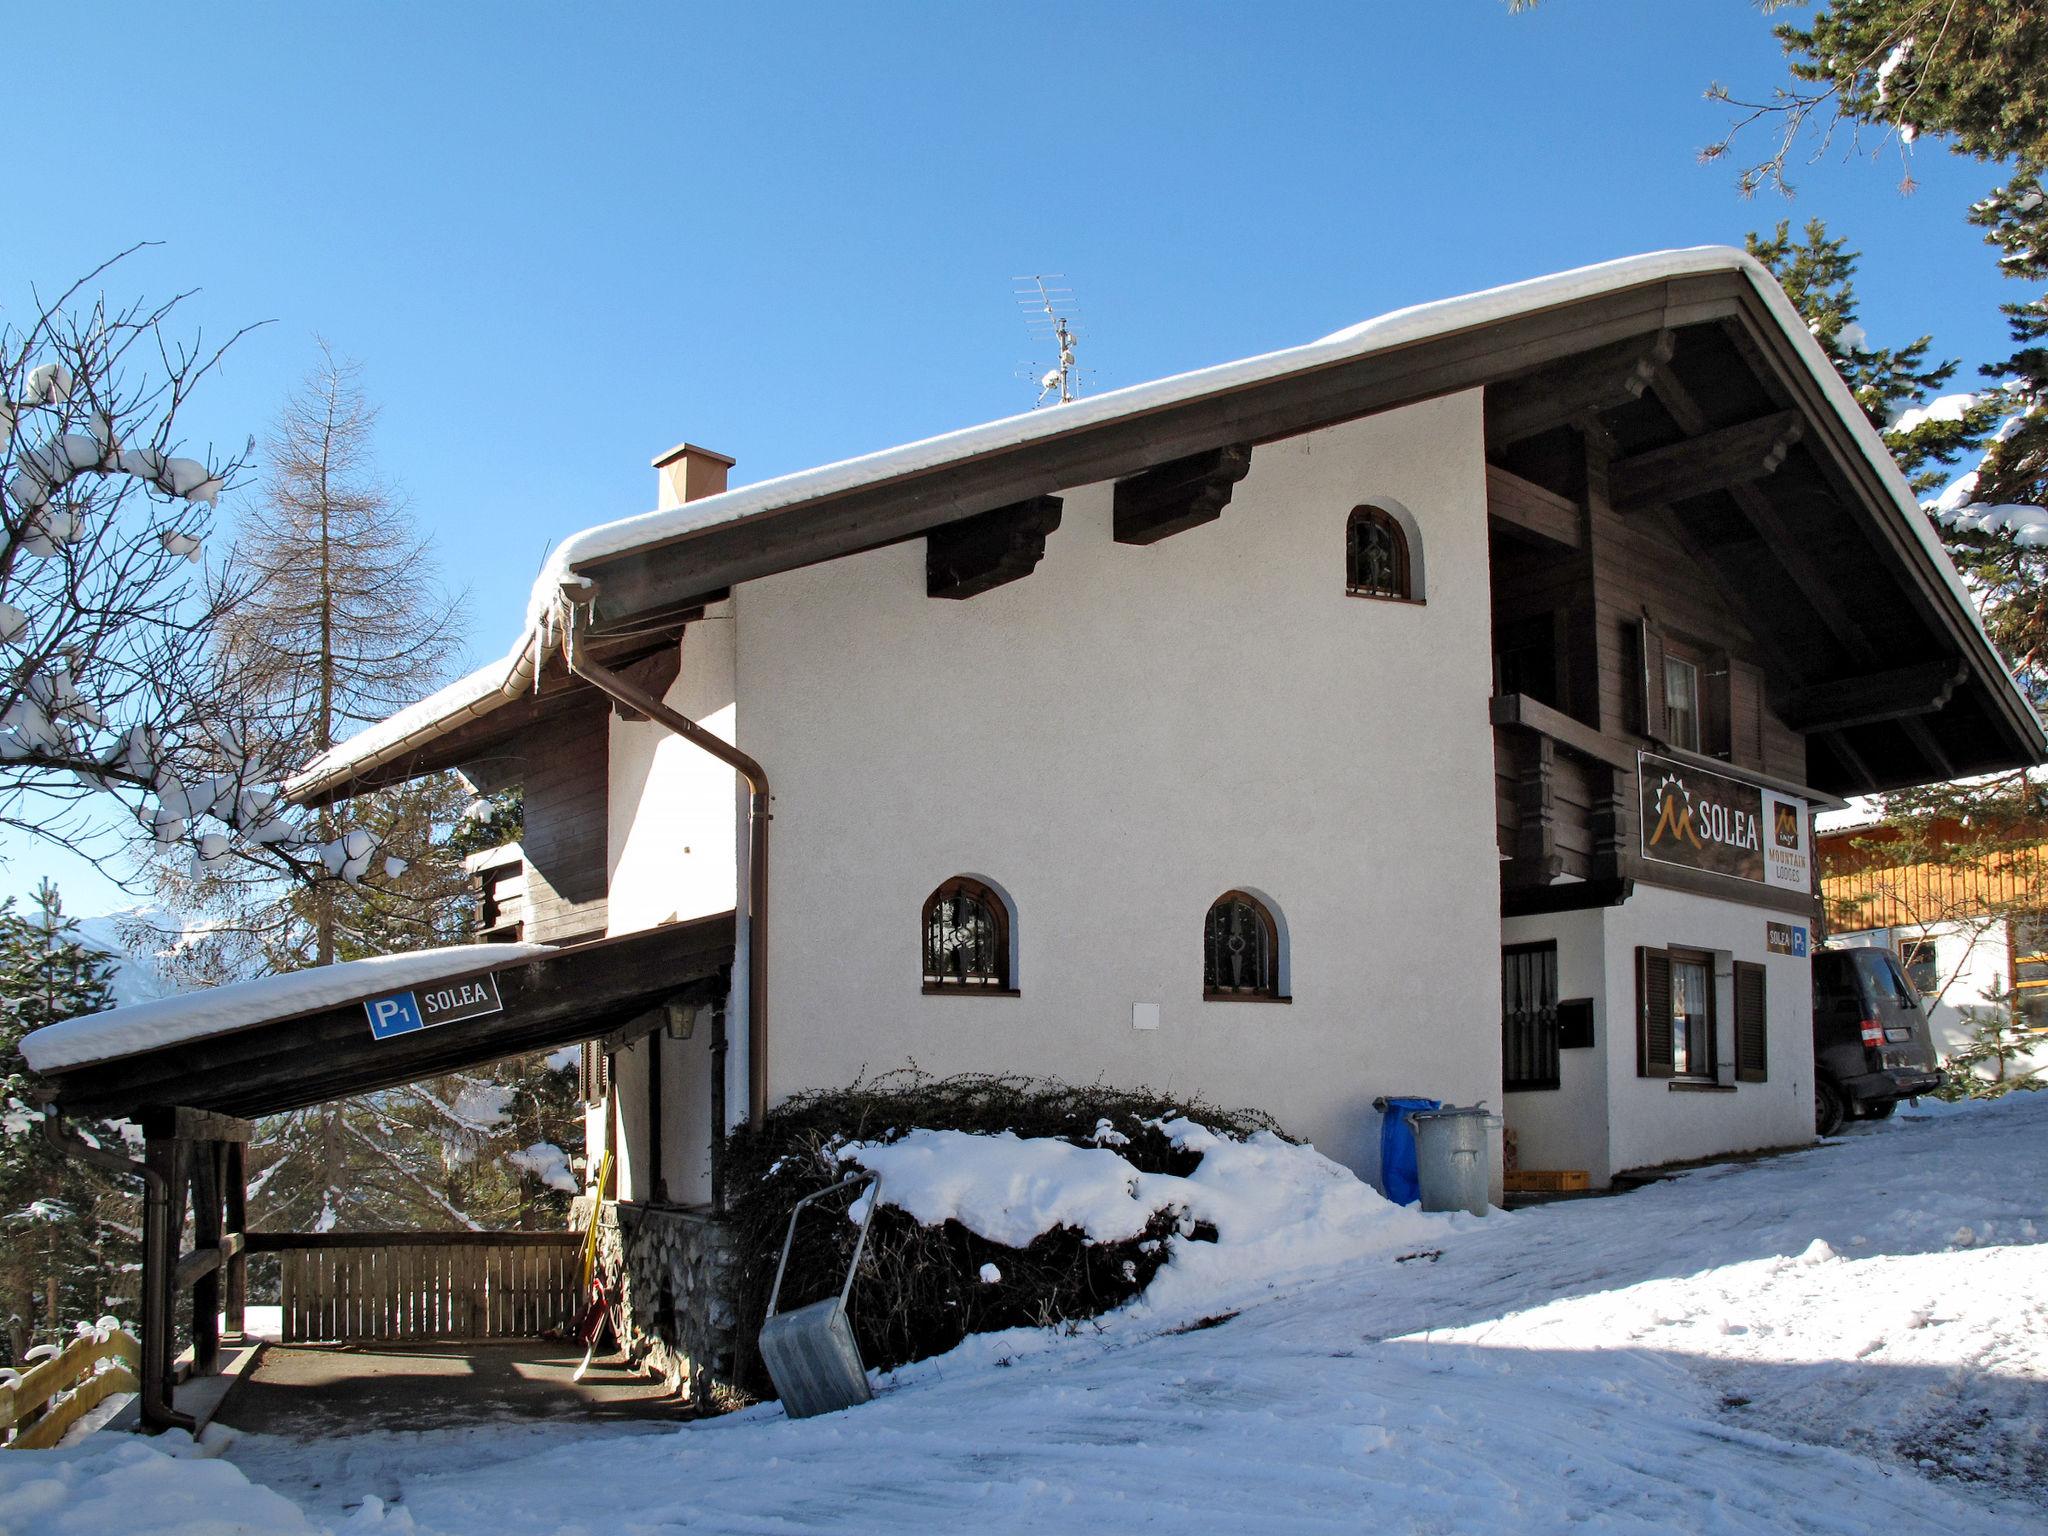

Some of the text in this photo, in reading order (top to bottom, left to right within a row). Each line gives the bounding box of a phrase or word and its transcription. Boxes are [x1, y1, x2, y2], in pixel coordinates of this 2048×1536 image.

[1699, 800, 1758, 851] SOLEA
[1768, 848, 1806, 869] MOUNTAIN
[1769, 930, 1790, 947] SOLEA
[425, 982, 489, 1013] SOLEA
